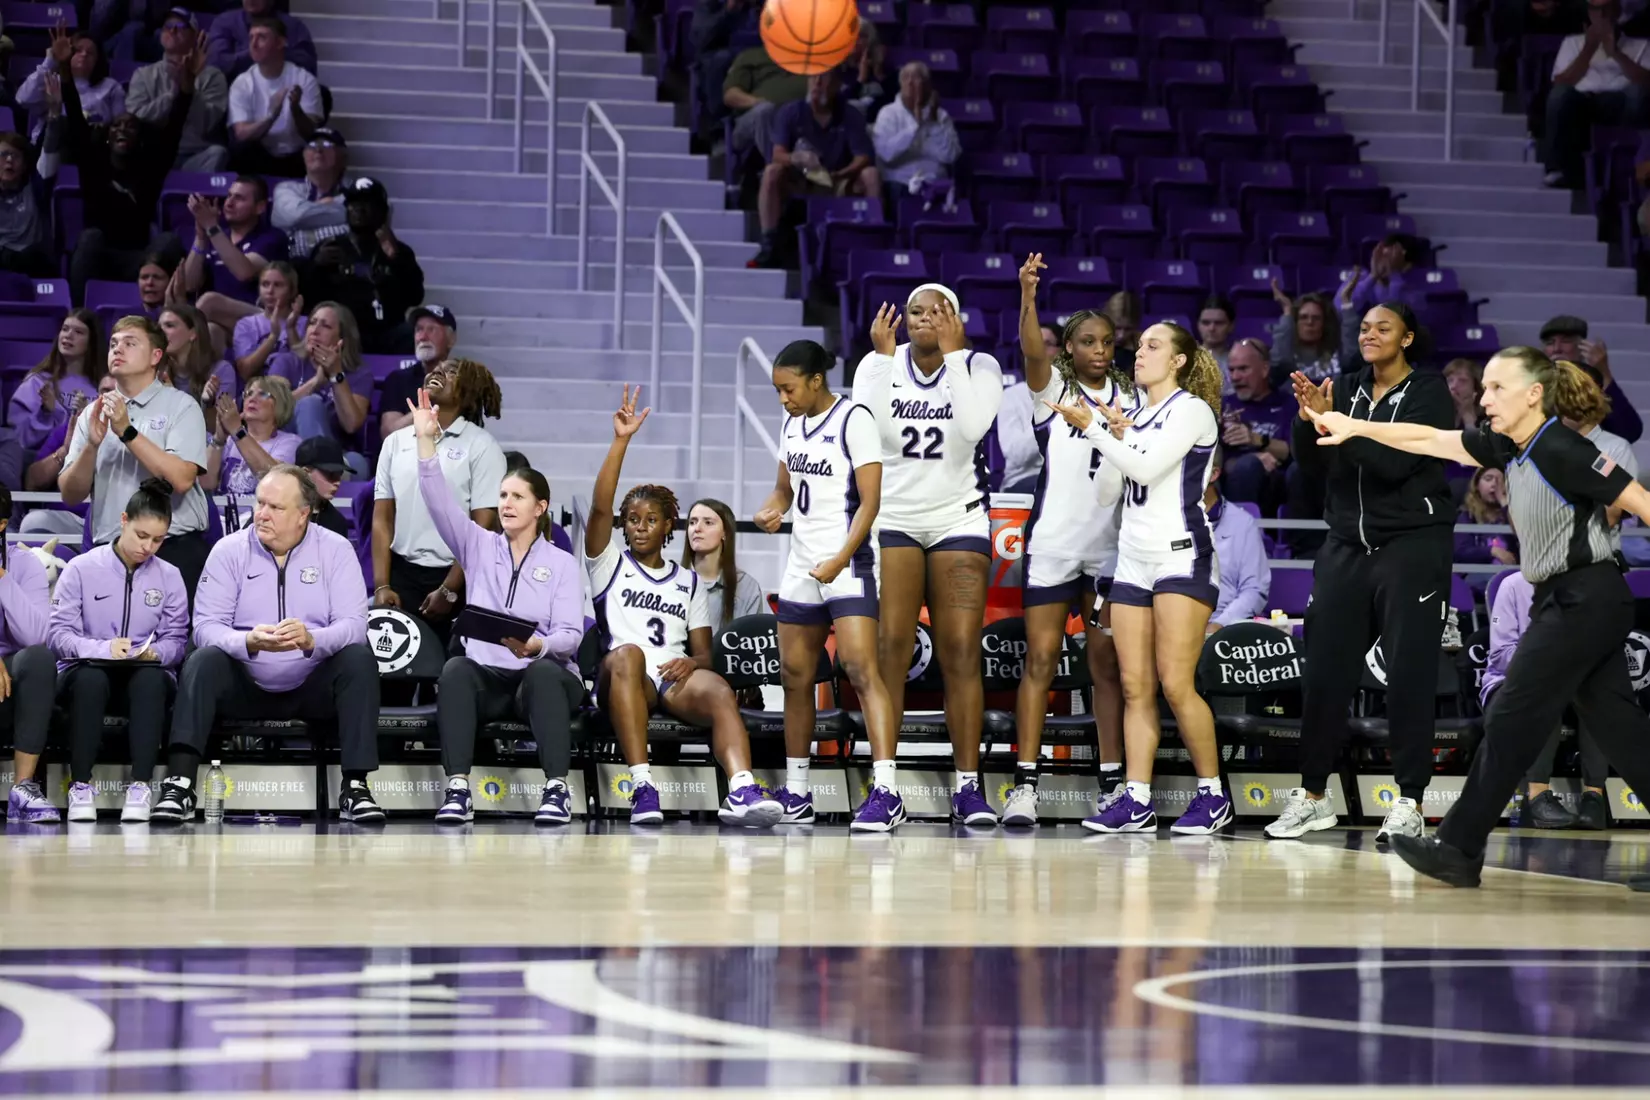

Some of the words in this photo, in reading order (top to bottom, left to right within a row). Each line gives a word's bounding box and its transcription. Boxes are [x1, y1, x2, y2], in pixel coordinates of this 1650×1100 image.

[891, 398, 953, 420] Wildcat
[901, 426, 944, 460] 22
[798, 479, 810, 517] 0
[995, 527, 1022, 560] G
[621, 588, 686, 621] Wildcats
[647, 617, 665, 648] 3
[721, 629, 778, 655] Capi
[981, 633, 1069, 658] Capl
[1214, 636, 1296, 664] Capitol
[724, 654, 780, 675] Fede
[1219, 657, 1302, 684] Federal
[95, 781, 123, 792] HUNG
[237, 781, 278, 792] HUNGER
[280, 781, 305, 792] FREE
[374, 781, 414, 792] HUNGER
[416, 781, 441, 792] FREE
[509, 784, 546, 795] HUNGE
[653, 781, 681, 793] NGER
[683, 782, 707, 793] FREE
[813, 785, 837, 795] FREE
[1038, 790, 1067, 801] NGER
[1068, 791, 1092, 802] FREE
[1272, 788, 1292, 799] HUN
[1423, 791, 1440, 801] GER
